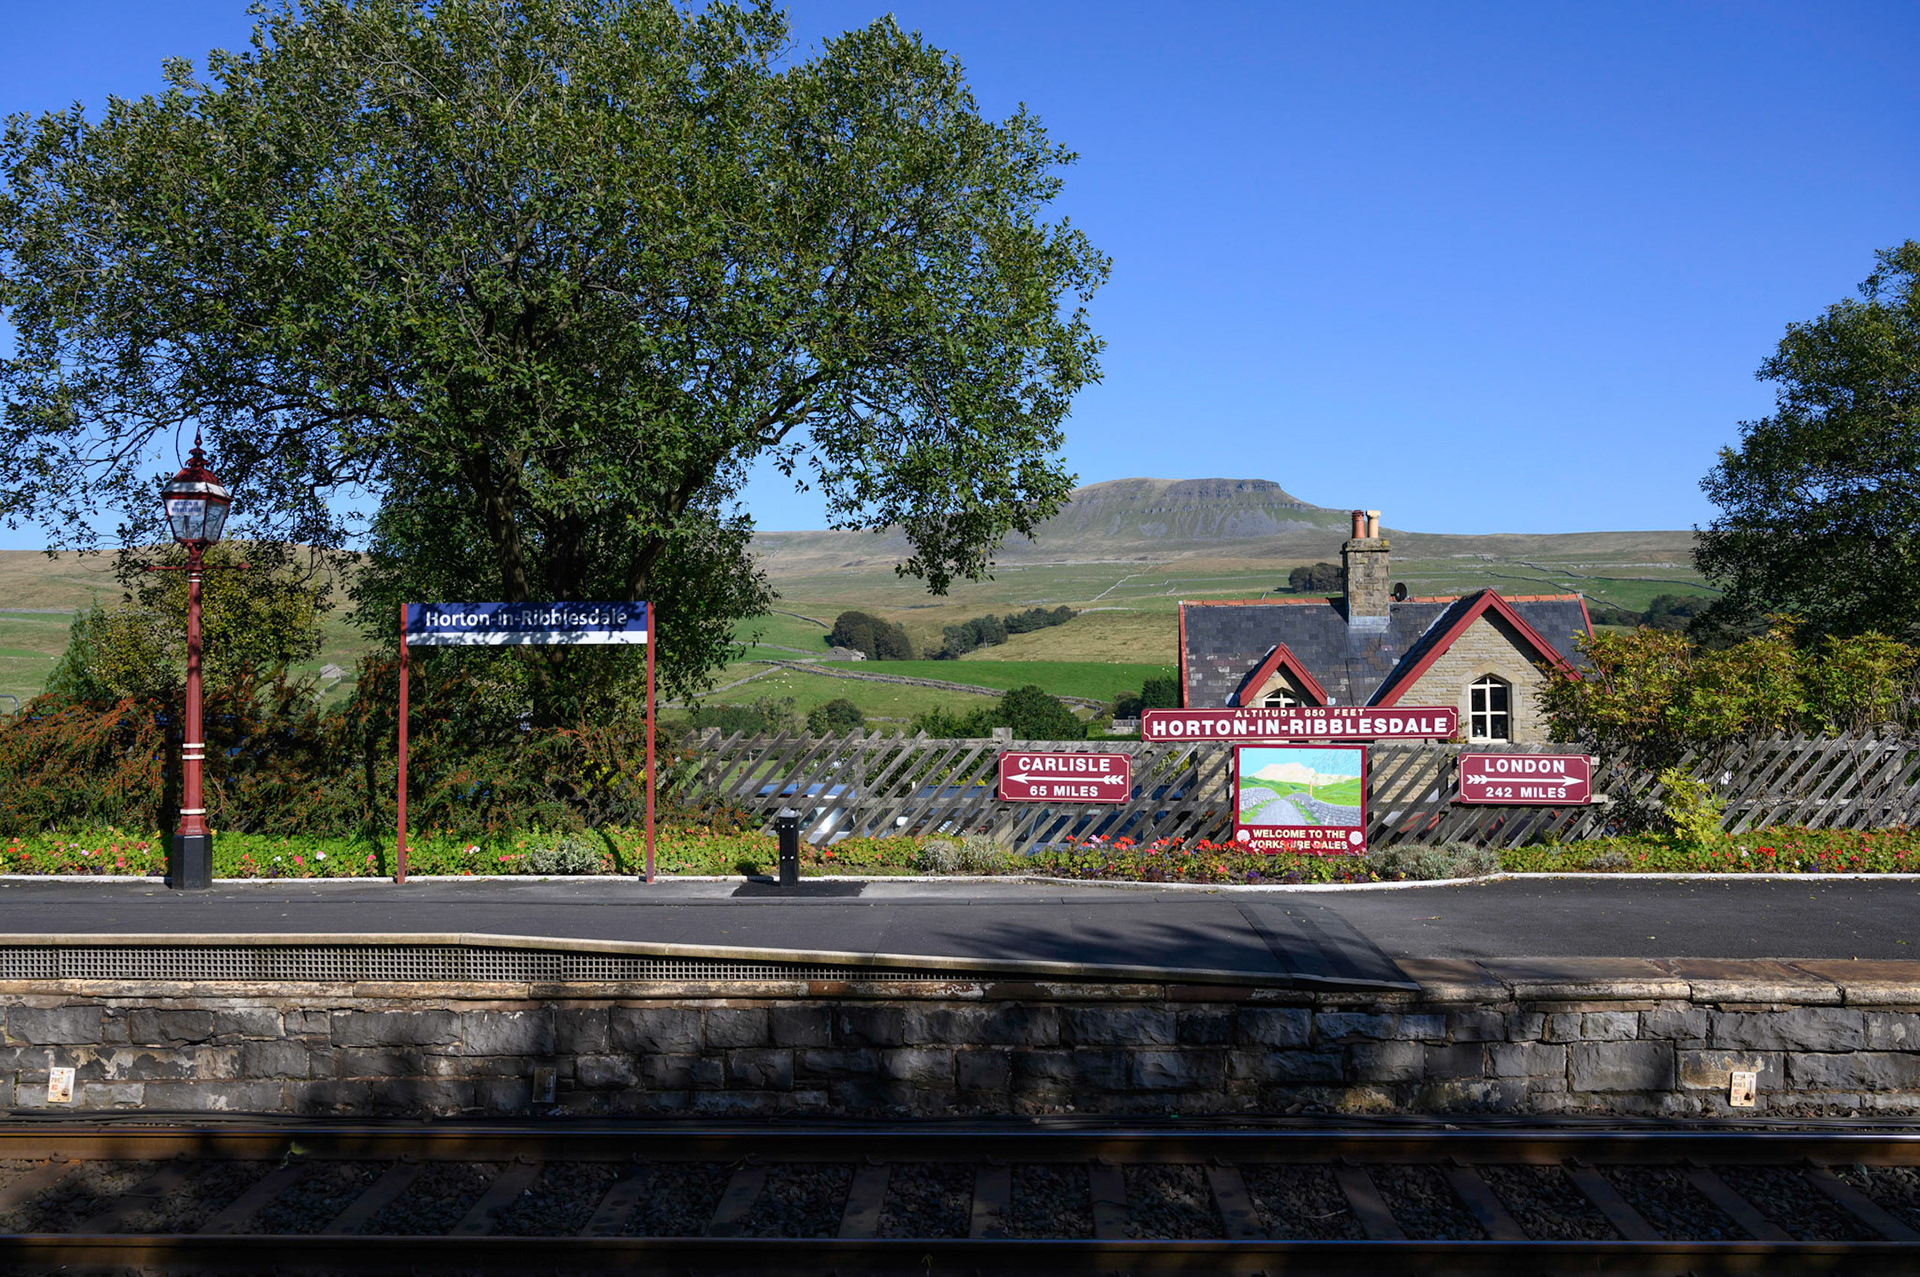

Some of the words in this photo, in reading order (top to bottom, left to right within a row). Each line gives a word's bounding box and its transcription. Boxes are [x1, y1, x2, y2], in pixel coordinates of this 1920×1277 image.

[426, 608, 627, 627] Horton-in-Ribblesdale
[1235, 709, 1296, 718] ALTITUDE
[1304, 709, 1326, 717] 850
[1334, 708, 1365, 717] FEET
[1151, 717, 1448, 736] HORTON-IN-RIBBLESDALE
[1018, 757, 1110, 772] CARLISLE
[1485, 759, 1565, 773] LONDON
[1029, 785, 1047, 797] 65
[1053, 785, 1098, 797] MILES
[1485, 787, 1512, 798] 242
[1520, 787, 1566, 799] MILES
[1252, 829, 1306, 838] WELCOME
[1309, 829, 1323, 838] TO
[1325, 830, 1346, 839] THE
